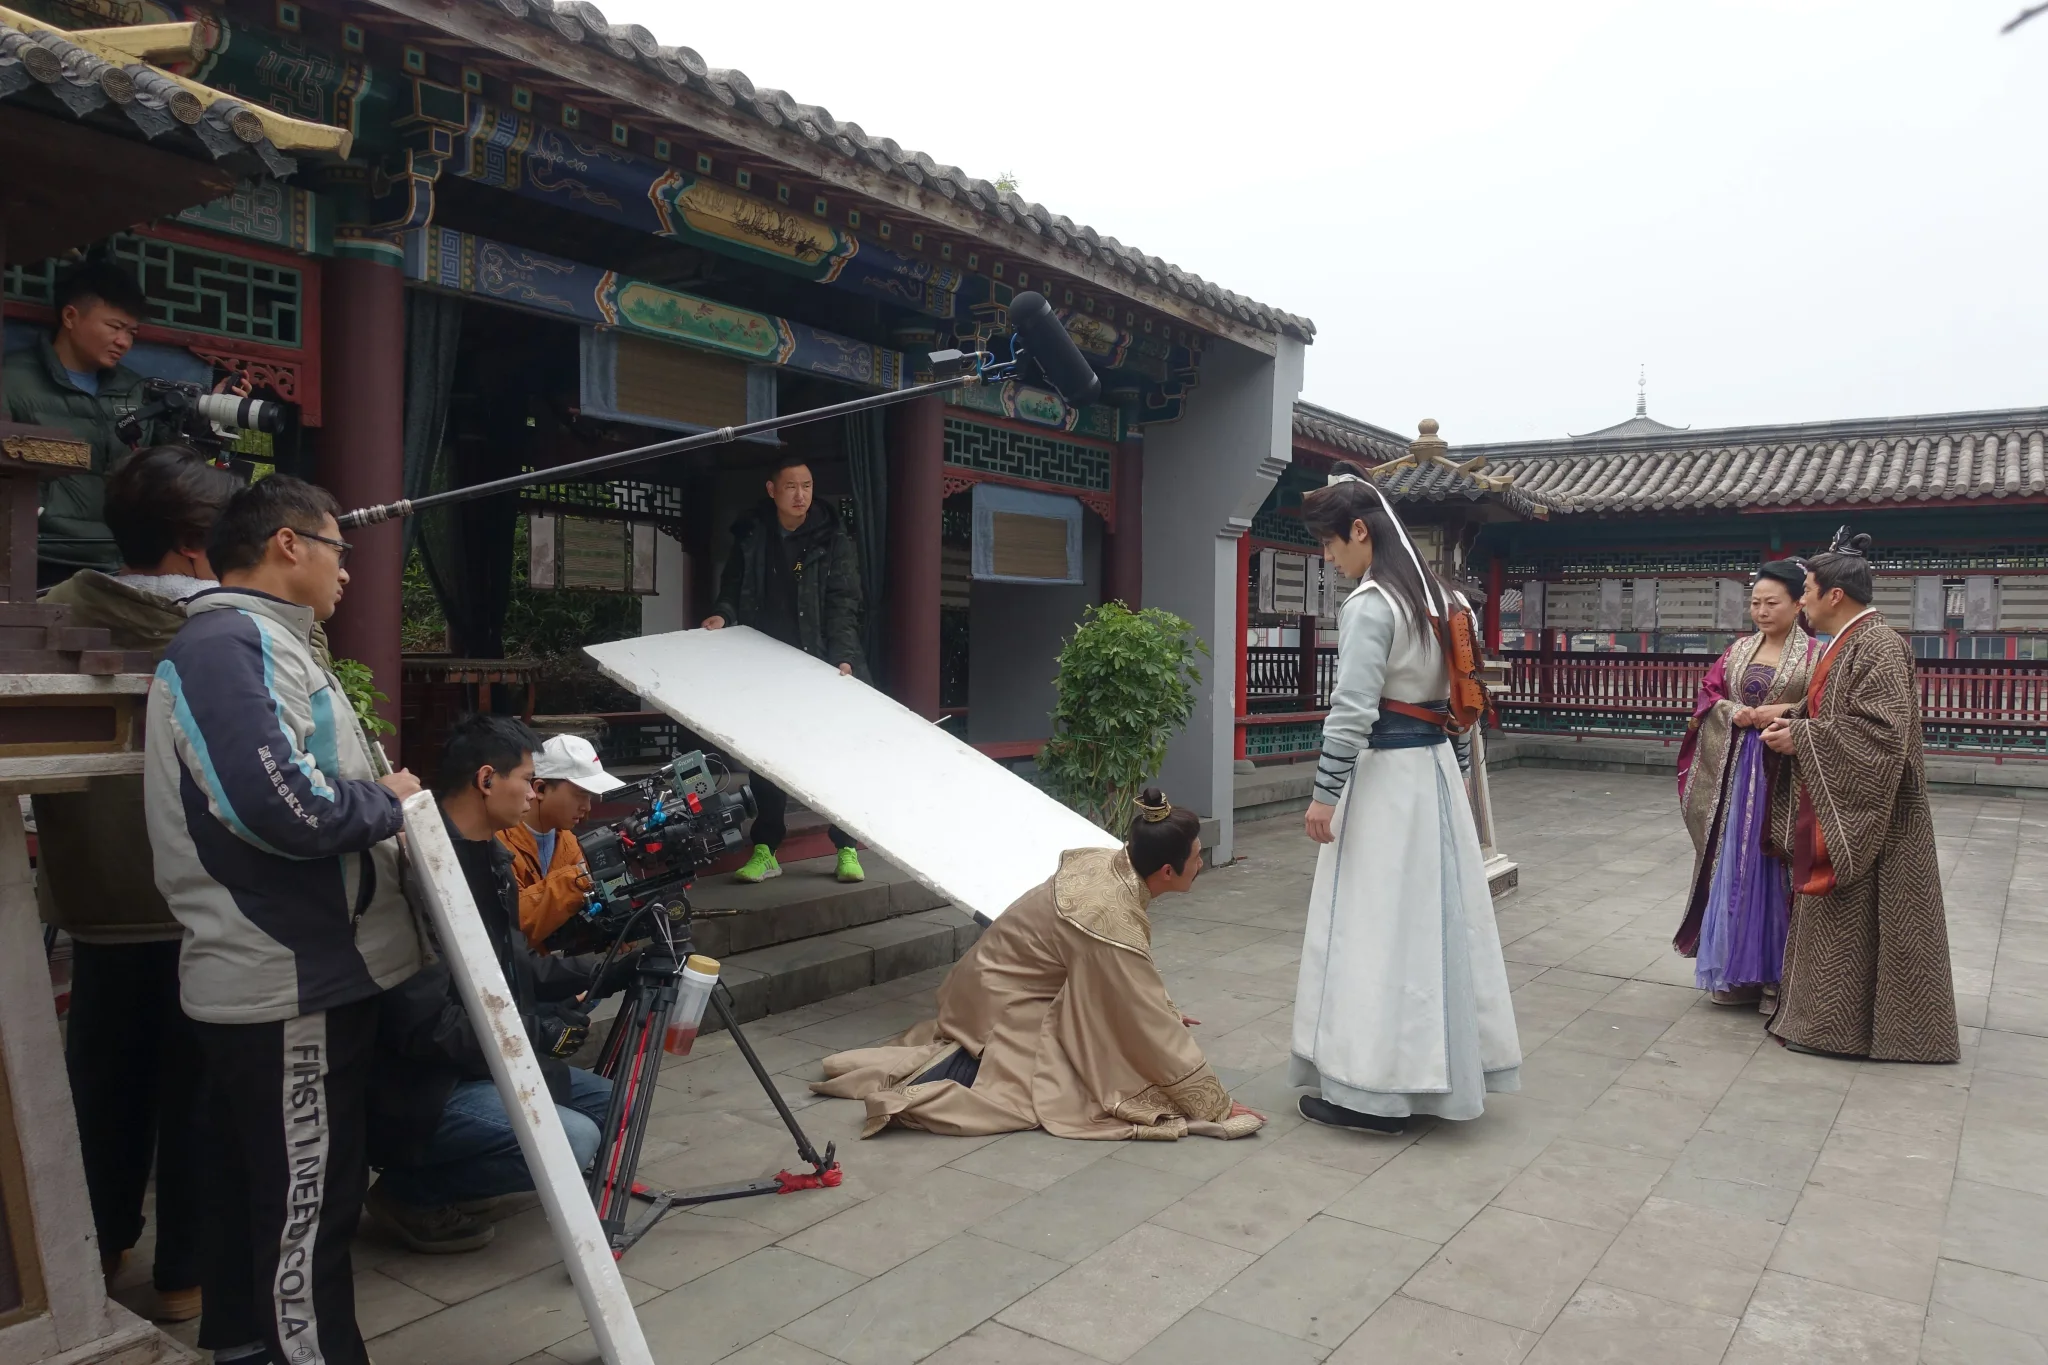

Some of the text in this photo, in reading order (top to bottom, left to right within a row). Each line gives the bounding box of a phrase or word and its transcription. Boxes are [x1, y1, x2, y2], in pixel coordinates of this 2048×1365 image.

[279, 1044, 320, 1341] FIRST I NEED COLA
